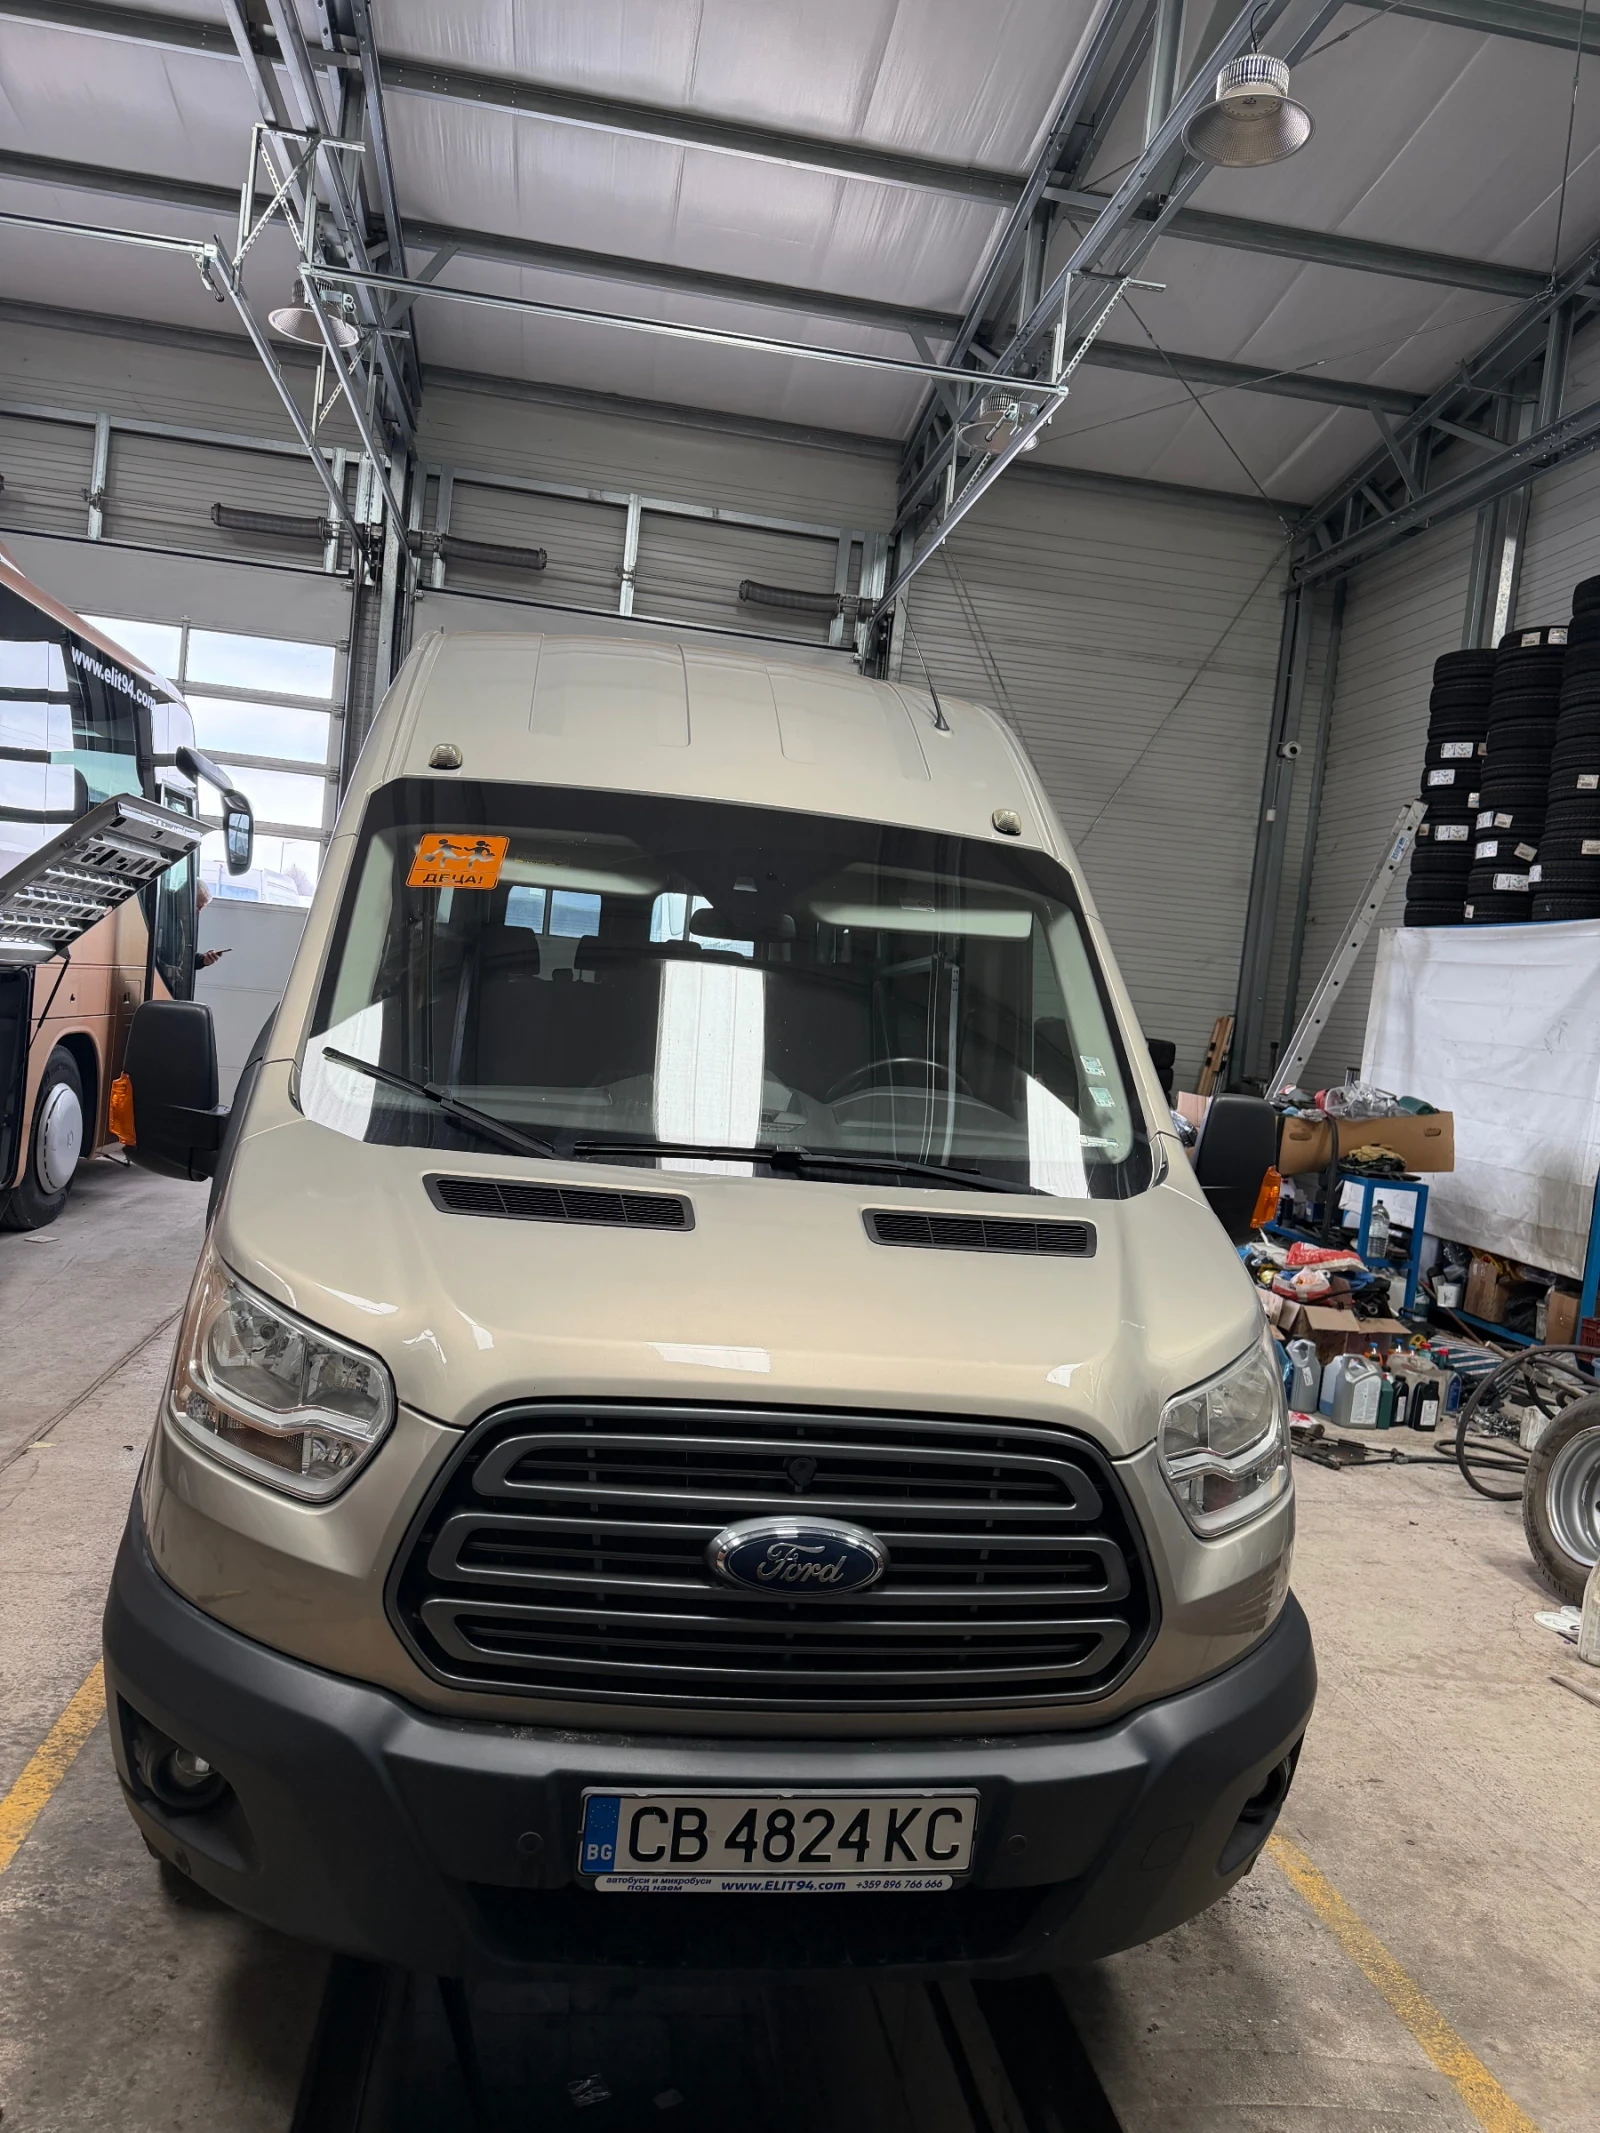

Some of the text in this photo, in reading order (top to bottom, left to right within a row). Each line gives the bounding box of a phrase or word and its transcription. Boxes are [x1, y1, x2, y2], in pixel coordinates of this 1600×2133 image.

[71, 645, 156, 710] www.elit94.com
[423, 873, 484, 884] ДЕЦА!
[756, 1542, 847, 1583] Ford
[724, 1808, 870, 1863] 4824
[587, 1844, 612, 1861] BG
[606, 1876, 650, 1885] автобуси
[660, 1876, 712, 1885] микробуси
[721, 1879, 943, 1891] www.ELIT94.com +359 896 766 666
